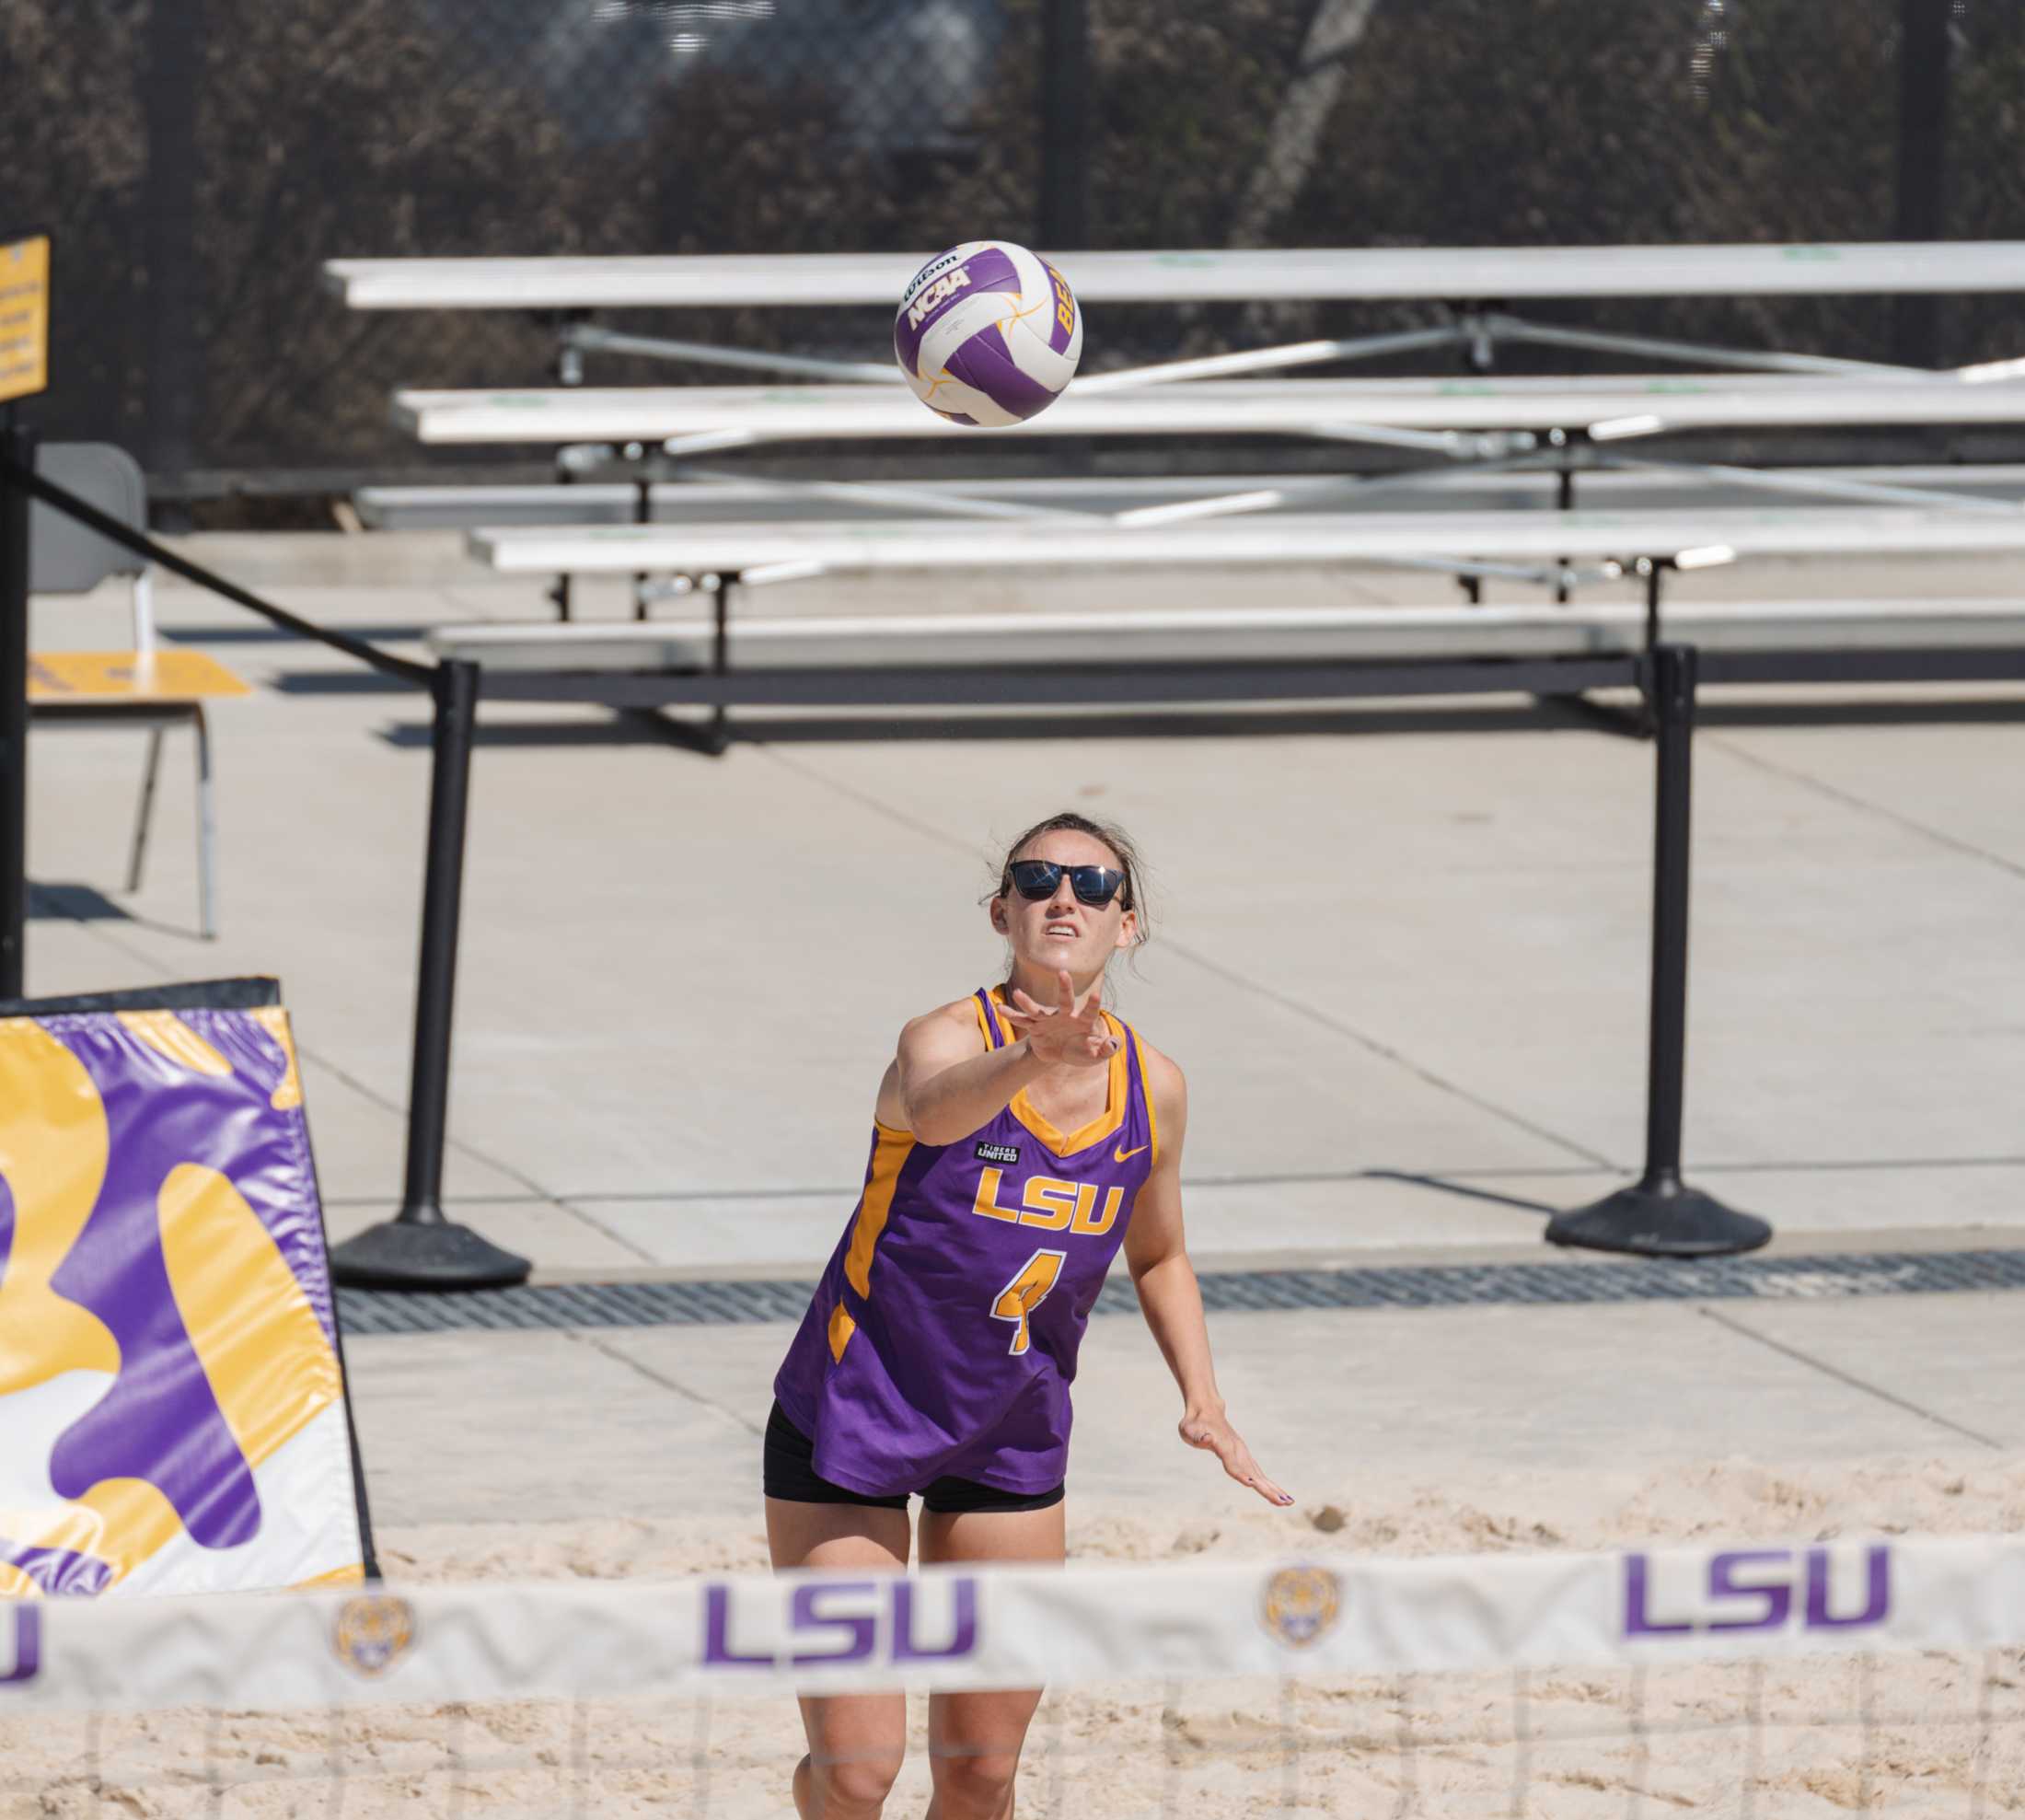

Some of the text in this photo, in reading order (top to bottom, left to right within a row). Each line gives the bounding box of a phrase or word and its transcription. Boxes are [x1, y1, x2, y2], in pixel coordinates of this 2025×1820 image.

[904, 255, 958, 302] Wilson
[908, 268, 972, 331] NCAA
[978, 1146, 1017, 1162] UNITED
[972, 1166, 1125, 1235] LSU
[989, 1248, 1067, 1356] 4
[702, 1578, 978, 1667] LSU
[1623, 1545, 1890, 1635] LSU
